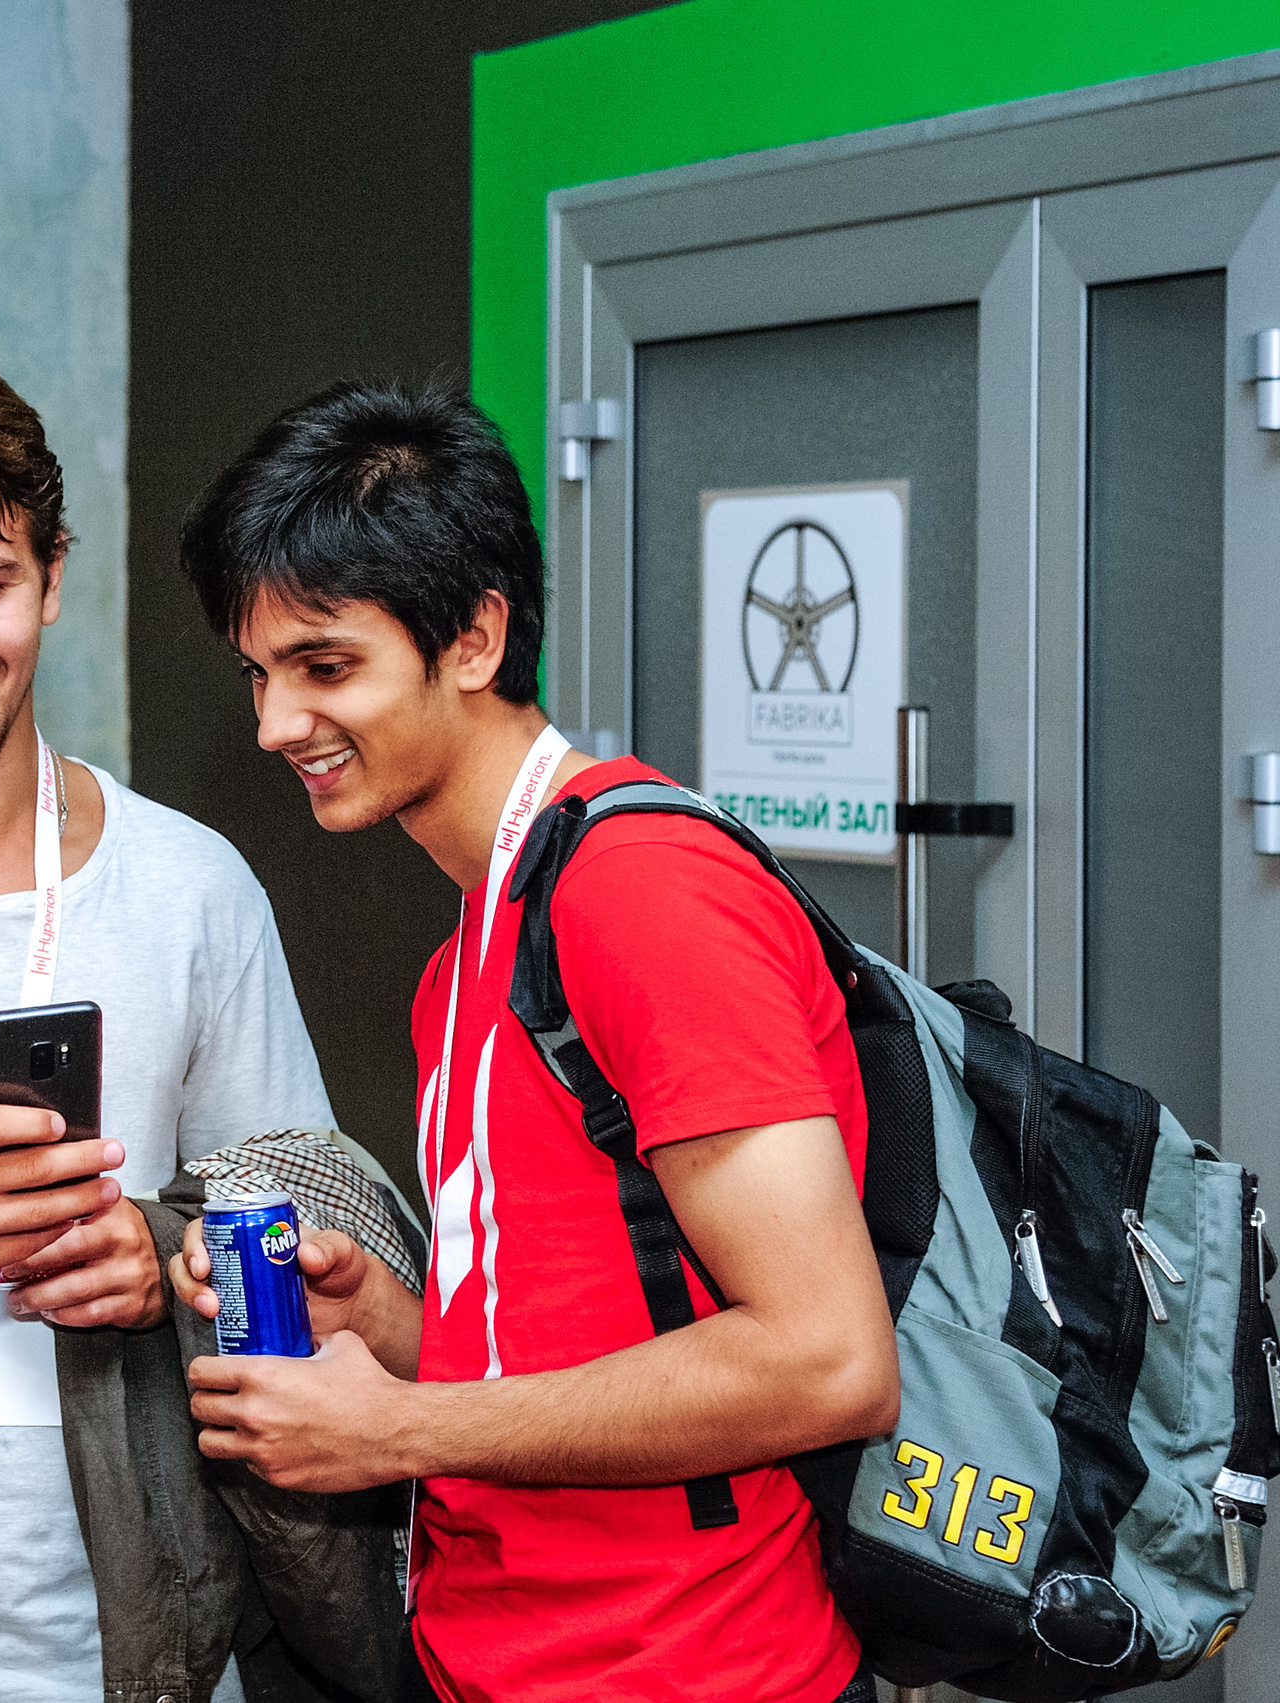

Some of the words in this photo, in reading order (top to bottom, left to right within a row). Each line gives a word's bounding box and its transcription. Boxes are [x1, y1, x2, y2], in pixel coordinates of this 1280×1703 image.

[755, 702, 845, 731] FABRIKA
[838, 800, 889, 834] ЗАЛ
[882, 1440, 1035, 1564] 313
